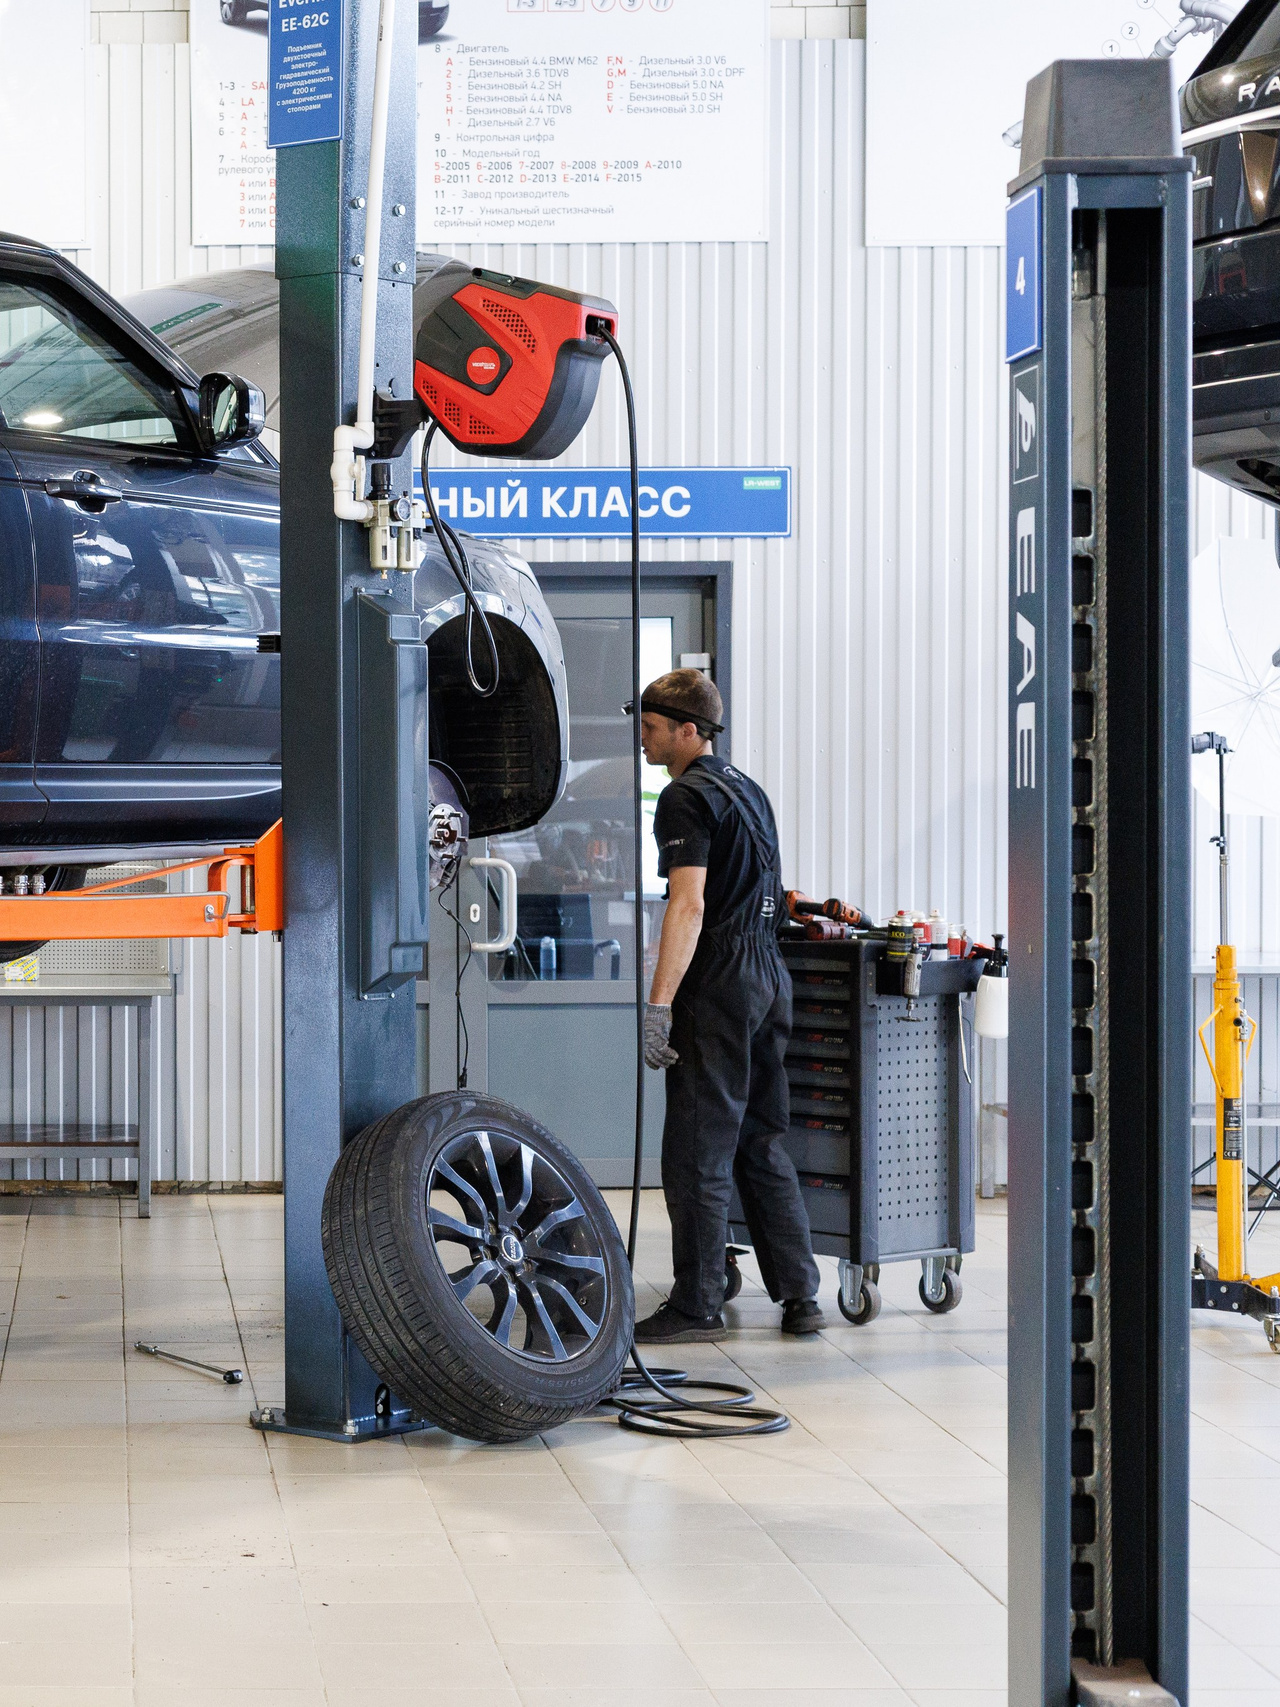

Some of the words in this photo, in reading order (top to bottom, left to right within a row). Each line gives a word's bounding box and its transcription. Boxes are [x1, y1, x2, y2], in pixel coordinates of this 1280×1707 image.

[281, 12, 329, 32] EE-62C
[1128, 27, 1134, 35] 2
[287, 43, 322, 53] Подъемник
[435, 44, 441, 53] 8
[456, 44, 509, 54] Двигатель
[1109, 45, 1113, 53] 1
[291, 61, 319, 70] электро-
[446, 57, 453, 66] A
[469, 56, 530, 66] Бензиновый
[532, 57, 547, 66] 4.4
[549, 57, 575, 65] BMW
[577, 56, 599, 65] M62
[607, 56, 623, 66] F,N
[639, 56, 694, 66] Дизельный
[696, 56, 712, 65] 3.0
[714, 56, 727, 65] V6
[280, 66, 330, 80] гидравлический
[446, 70, 452, 78] 2
[467, 69, 524, 79] Дизельный
[526, 69, 540, 78] 3.6
[544, 69, 569, 78] TDV8
[607, 69, 627, 79] G,M
[642, 68, 698, 79] Дизельный
[700, 68, 715, 77] 3.0
[725, 68, 746, 77] DPF
[219, 82, 236, 90] 1-3
[276, 76, 334, 91] Грузоподъемность
[446, 82, 452, 91] 3
[467, 81, 528, 91] Бензиновый
[530, 81, 545, 90] 4.2
[548, 81, 562, 90] SH
[607, 81, 614, 90] D
[630, 80, 690, 90] Бензиновый
[692, 80, 707, 89] 5.0
[709, 80, 724, 89] NA
[292, 87, 309, 95] 4200
[219, 97, 225, 106] 4
[241, 97, 255, 106] LA
[281, 93, 333, 106] электрическими
[446, 94, 452, 103] 5
[467, 93, 528, 103] Бензиновый
[530, 94, 545, 102] 4.4
[548, 93, 563, 102] NA
[607, 93, 613, 102] E
[629, 92, 690, 102] Бензиновый
[692, 92, 707, 101] 5.0
[709, 92, 723, 101] SH
[287, 103, 322, 113] стопорами
[446, 106, 453, 115] H
[466, 105, 527, 115] Бензиновый
[529, 106, 544, 114] 4.4
[547, 105, 572, 114] TDV8
[607, 105, 614, 114] V
[626, 104, 687, 114] Бензиновый
[689, 104, 704, 113] 3.0
[706, 104, 721, 113] SH
[219, 112, 225, 121] 5
[241, 112, 248, 120] A
[446, 118, 451, 127] 1
[467, 117, 523, 128] Дизельный
[525, 118, 540, 127] 2.7
[543, 117, 556, 126] V6
[219, 127, 225, 136] 6
[241, 127, 247, 135] 2
[434, 133, 441, 142] 9
[456, 133, 521, 144] Контрольная
[523, 133, 555, 144] цифра
[240, 141, 247, 149] A
[435, 149, 447, 158] 10
[462, 148, 520, 159] Модельный
[522, 149, 540, 159] год
[219, 155, 224, 163] 7
[434, 161, 470, 171] 5-2005
[476, 161, 513, 171] 6-2006
[519, 161, 554, 170] 7-2007
[560, 161, 597, 170] 8-2008
[602, 160, 639, 170] 9-2009
[645, 160, 682, 169] A-2010
[218, 166, 264, 176] рулевого
[240, 179, 245, 187] 4
[434, 174, 471, 184] B-2011
[477, 174, 514, 183] C-2012
[520, 174, 557, 183] D-2013
[563, 174, 600, 183] E-2014
[606, 174, 642, 183] F-2015
[240, 193, 245, 201] 3
[434, 190, 445, 199] 11
[462, 190, 492, 200] Завод
[494, 189, 570, 200] производитель
[240, 206, 245, 214] 8
[434, 206, 464, 216] 12-17
[480, 205, 540, 216] Уникальный
[542, 205, 615, 216] шестизначный
[240, 219, 245, 228] 7
[433, 218, 482, 228] серийный
[484, 218, 515, 228] номер
[517, 218, 556, 228] модели
[1015, 256, 1026, 295] 4
[542, 485, 691, 519] КЛАСС
[1016, 506, 1036, 789] EAE
